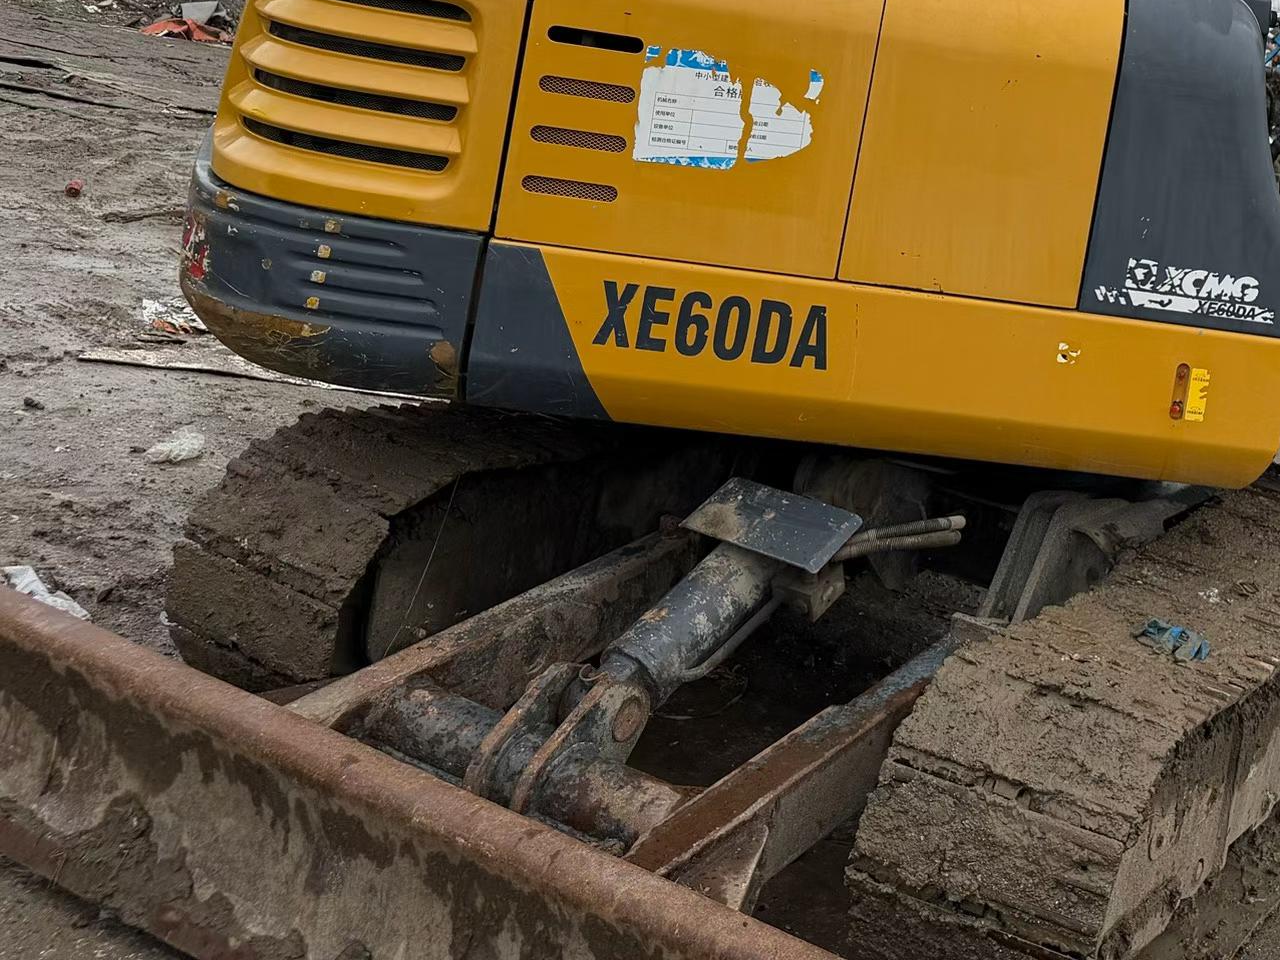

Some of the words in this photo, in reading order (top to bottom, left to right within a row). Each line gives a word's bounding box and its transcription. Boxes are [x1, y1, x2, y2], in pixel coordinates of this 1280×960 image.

[713, 85, 742, 99] 合格
[1157, 266, 1260, 302] XCMG
[592, 280, 828, 371] XE60DA
